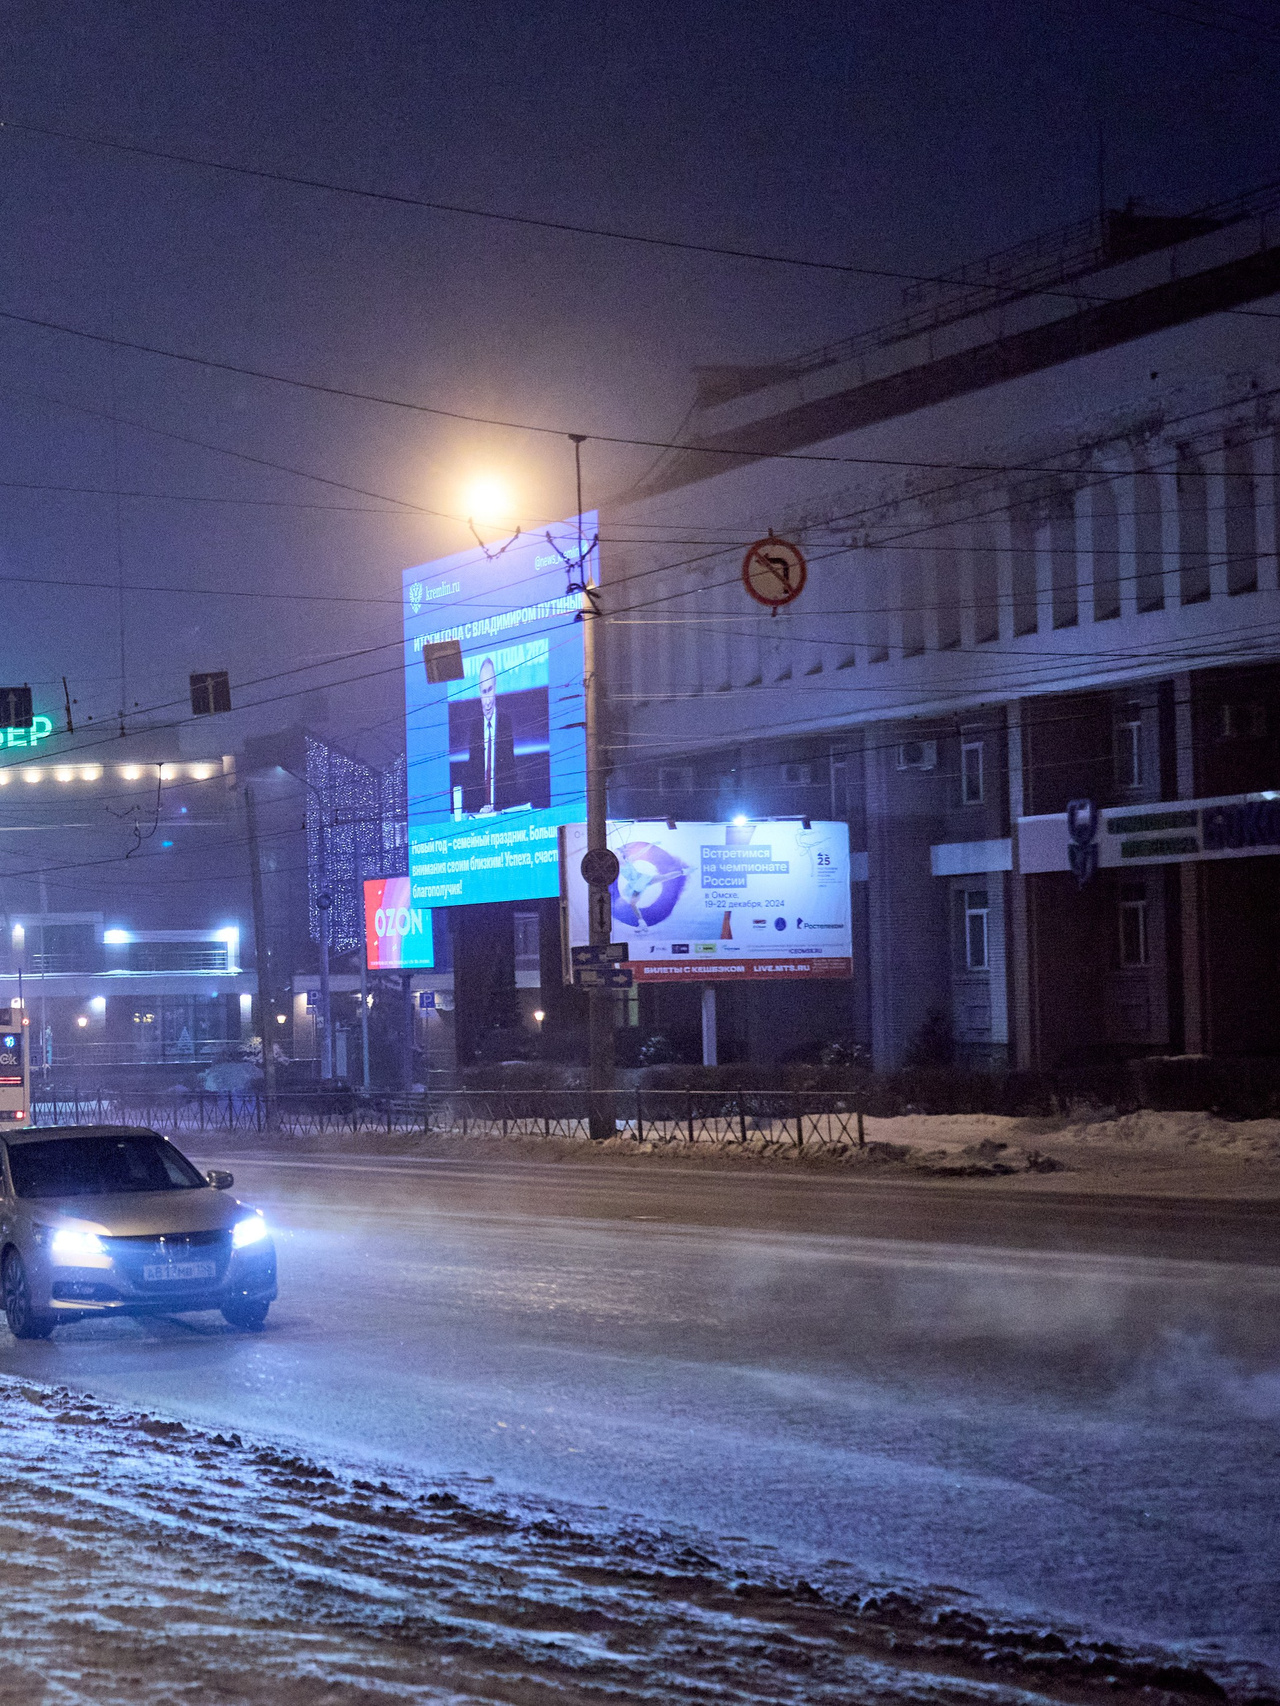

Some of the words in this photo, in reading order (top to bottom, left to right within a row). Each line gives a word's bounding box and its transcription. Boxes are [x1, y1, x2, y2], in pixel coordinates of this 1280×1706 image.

[425, 580, 461, 601] kremlin.ru
[464, 624, 472, 639] С
[472, 607, 537, 636] ВЛАДИМИРОМ
[411, 838, 435, 855] Новый
[435, 839, 448, 854] год
[452, 831, 490, 850] семейный
[490, 830, 529, 848] праздник.
[702, 848, 770, 860] Встретимся
[412, 862, 447, 877] внимания
[447, 859, 470, 873] своим
[470, 853, 504, 870] близким!
[505, 850, 533, 868] Успеха,
[817, 856, 831, 866] 25
[703, 864, 717, 872] на
[719, 863, 788, 872] чемпионате
[703, 875, 745, 886] России
[412, 879, 463, 900] благополучия!
[764, 899, 785, 908] 2024
[374, 906, 423, 938] OZON
[643, 966, 683, 974] БИЛЕТЫ
[691, 965, 745, 973] КЕШБЭКОМ
[753, 964, 811, 972] LIVE.MTS.RU
